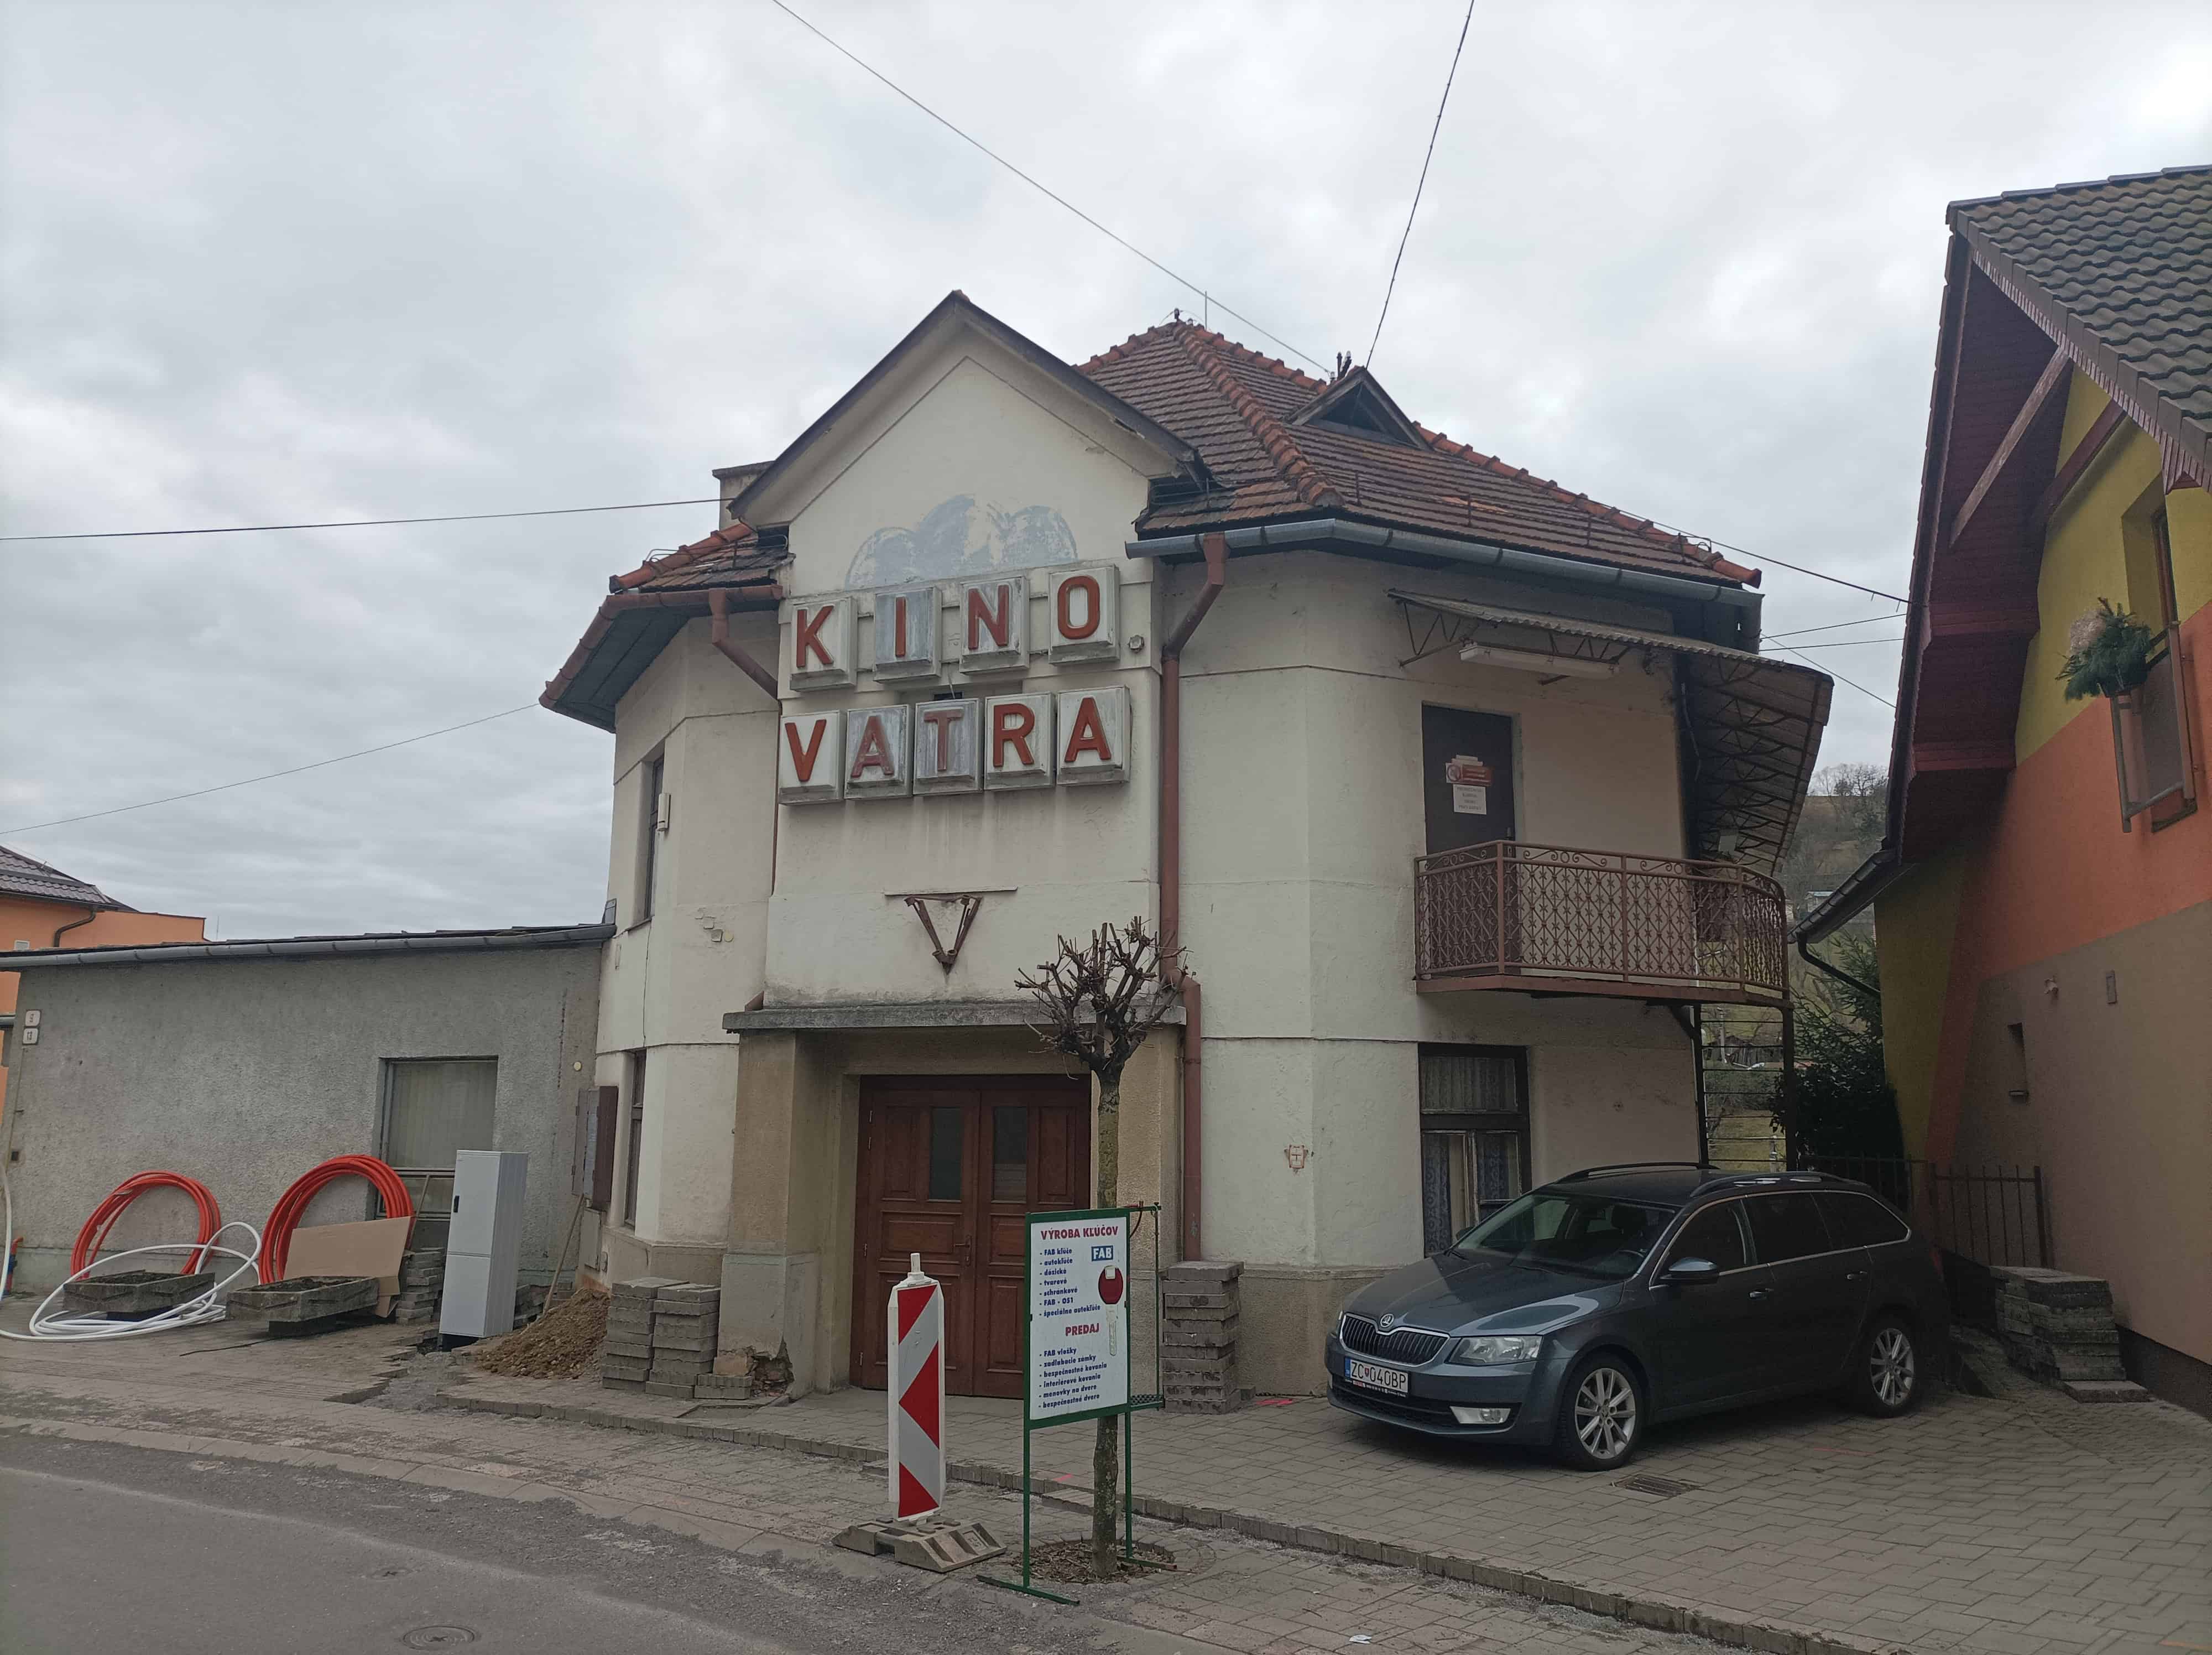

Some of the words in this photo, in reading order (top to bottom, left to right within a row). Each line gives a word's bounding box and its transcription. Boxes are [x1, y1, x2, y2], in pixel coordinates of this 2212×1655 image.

[796, 575, 1100, 668] KINO
[784, 696, 1112, 782] VATRA
[1041, 1227, 1081, 1240] VÝROBA
[1093, 1247, 1112, 1260] FAB
[1065, 1323, 1099, 1336] PREDAJ
[1085, 1362, 1107, 1371] kovania
[1078, 1373, 1101, 1382] kovania
[1044, 1388, 1071, 1398] menovky
